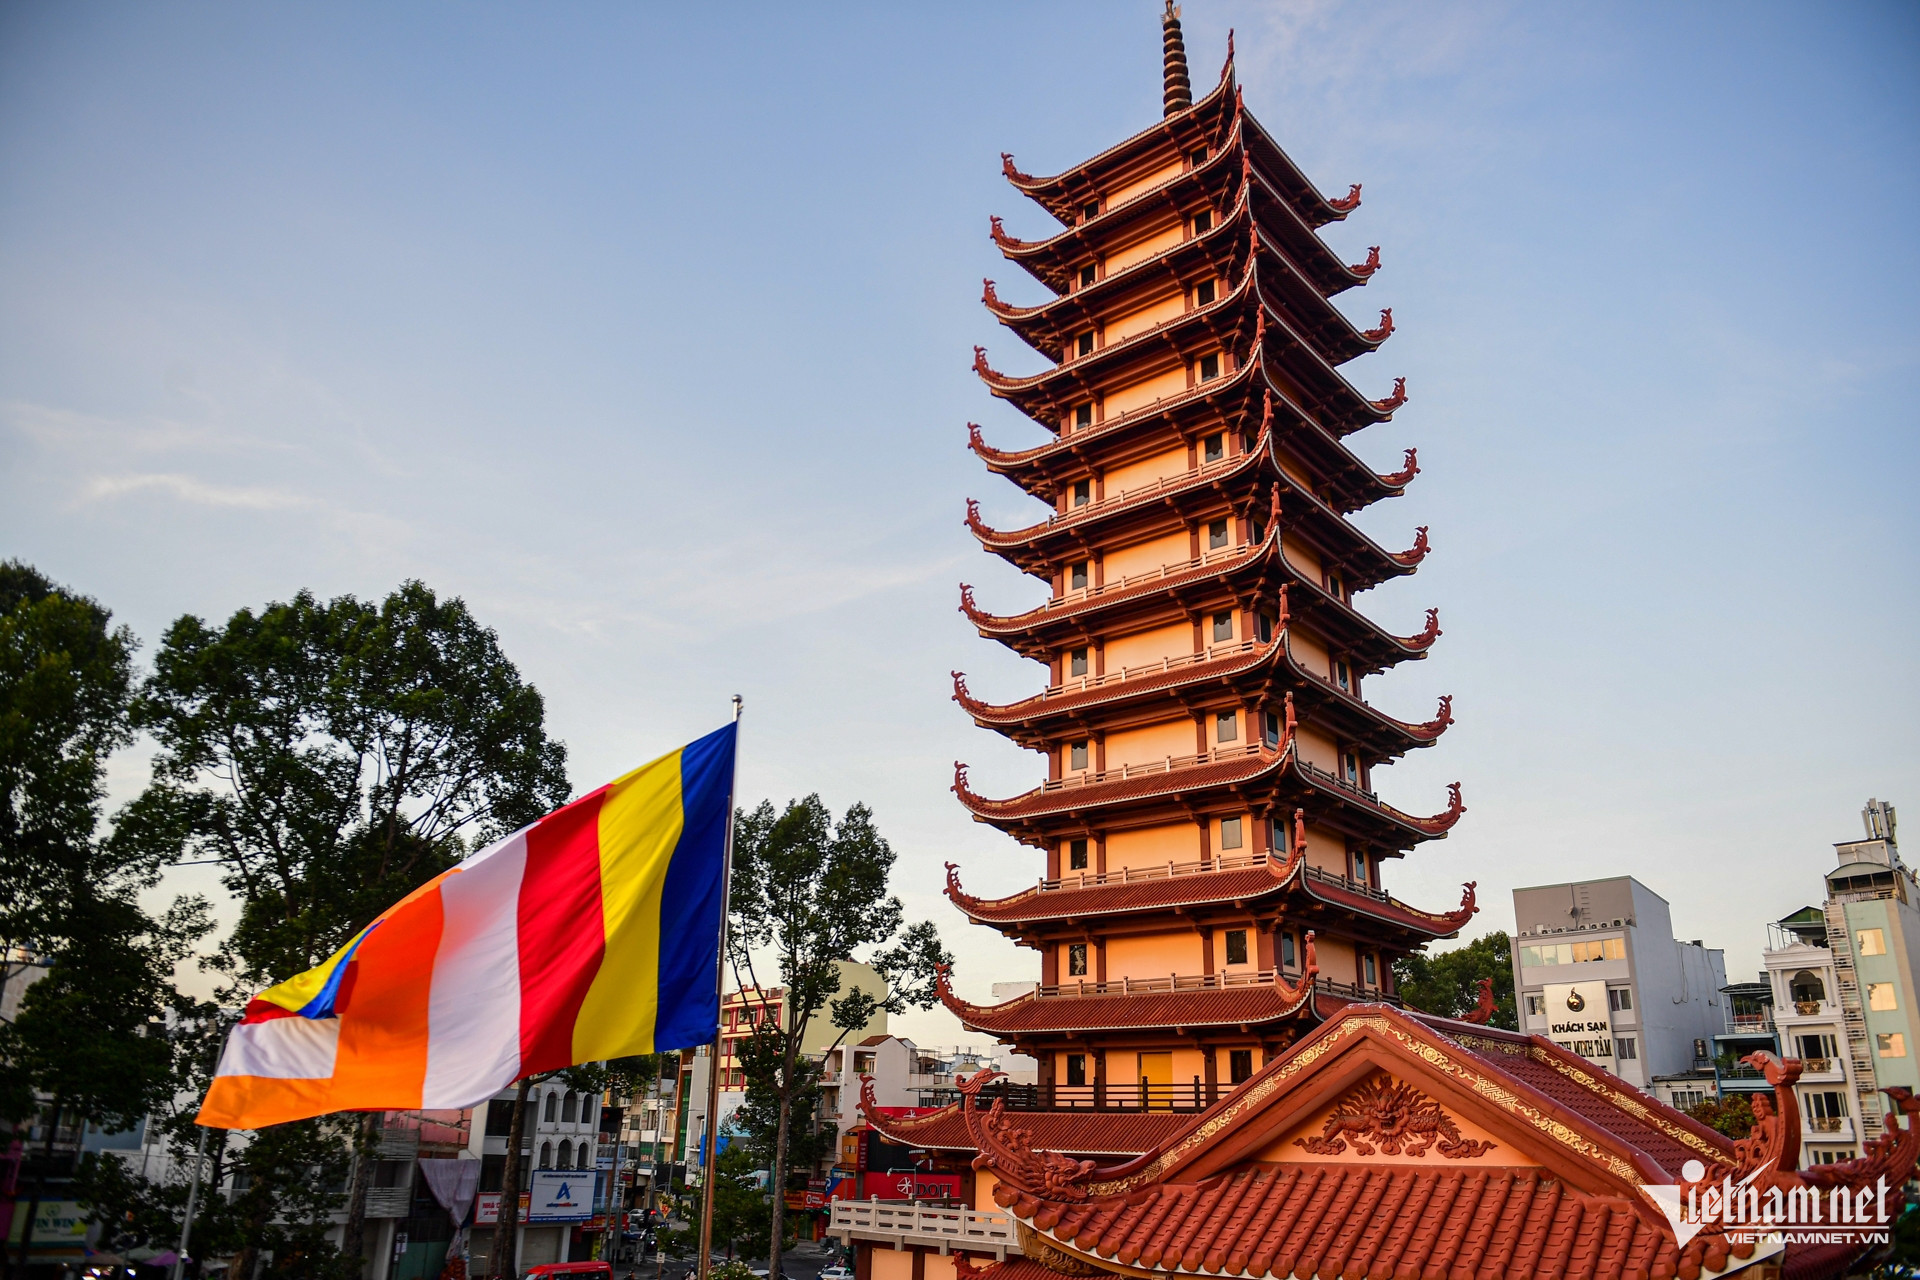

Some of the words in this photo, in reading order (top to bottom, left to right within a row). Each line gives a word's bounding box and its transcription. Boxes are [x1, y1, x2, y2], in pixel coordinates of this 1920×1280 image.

[1552, 1021, 1585, 1034] KHÁCH
[1587, 1022, 1607, 1034] SẠN
[1573, 1040, 1594, 1057] MINH
